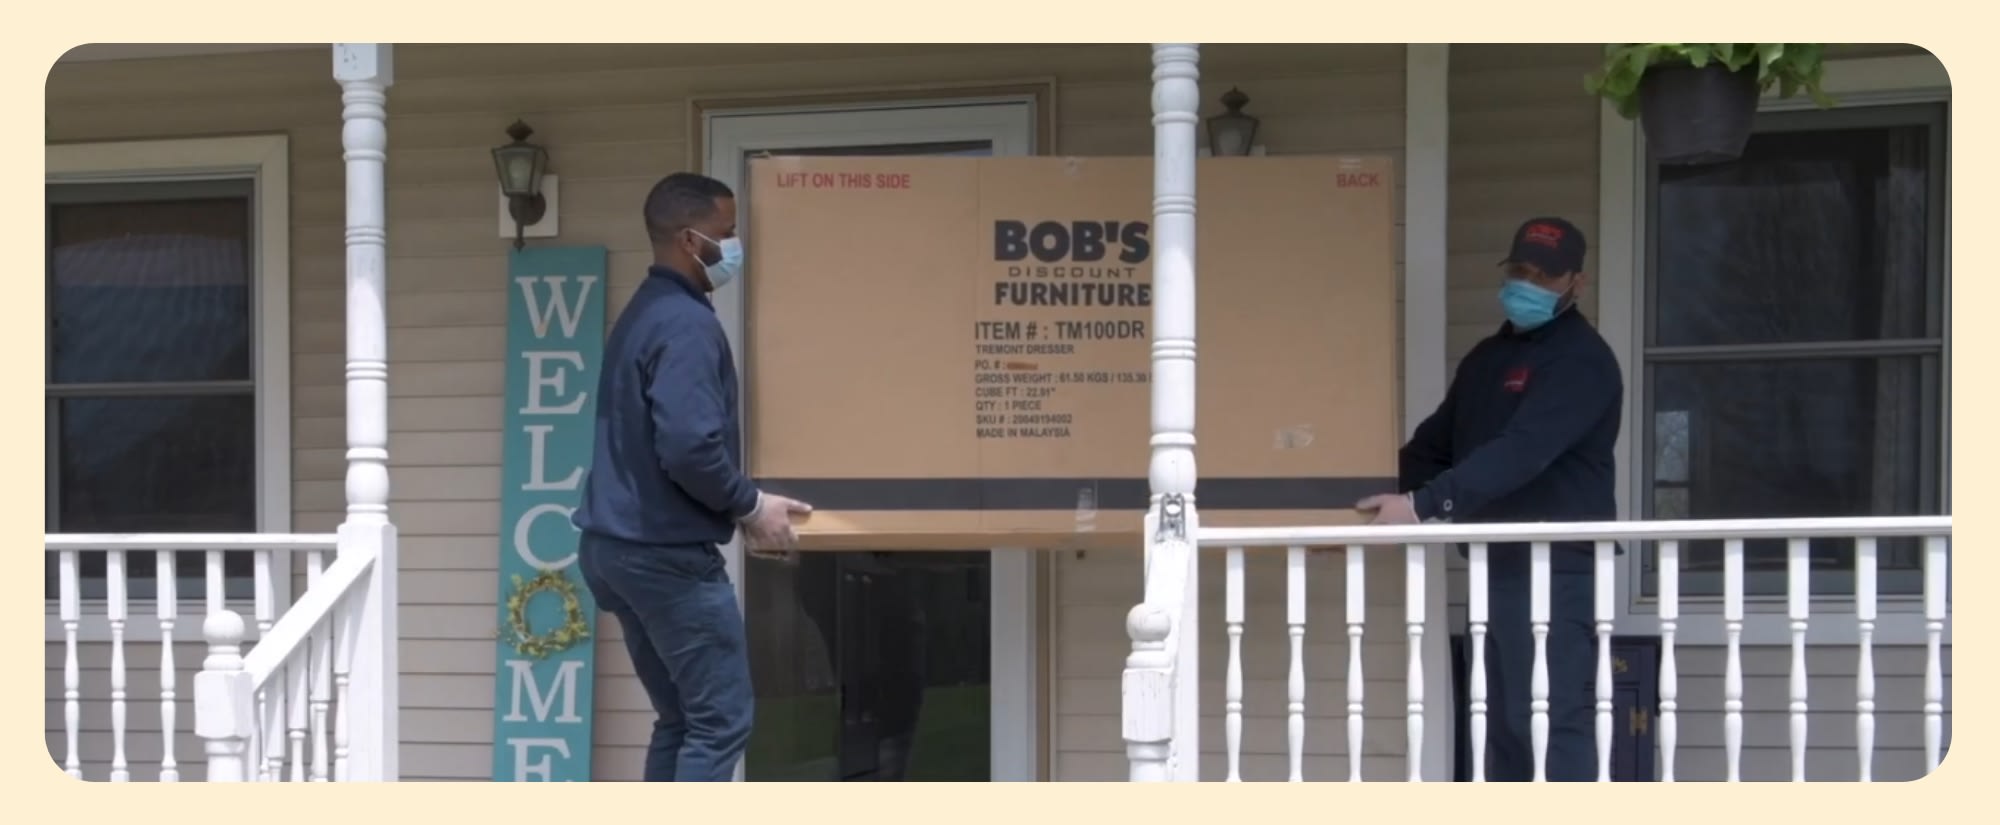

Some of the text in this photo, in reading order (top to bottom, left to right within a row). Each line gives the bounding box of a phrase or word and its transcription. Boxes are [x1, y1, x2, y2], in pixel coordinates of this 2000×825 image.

[777, 172, 911, 189] LIFT ON THIS SIDE
[1336, 173, 1380, 188] BACK
[994, 220, 1151, 264] BOB'S
[1008, 266, 1136, 278] DISCOUNT
[995, 282, 1152, 306] FURNITURE
[975, 321, 1020, 340] ITEM
[1026, 322, 1038, 340] #
[1055, 320, 1145, 340] TM100DR
[976, 344, 1075, 354] TREMONT DRESSER
[975, 373, 1010, 384] GROSS
[1012, 373, 1052, 384] WEIGHT
[975, 387, 1003, 397] CUBE
[1006, 387, 1017, 396] FT
[976, 400, 995, 411] QTY
[1012, 400, 1042, 410] PIECE
[976, 414, 996, 424] SKU
[976, 427, 1071, 438] MADE IN MALAYSIA
